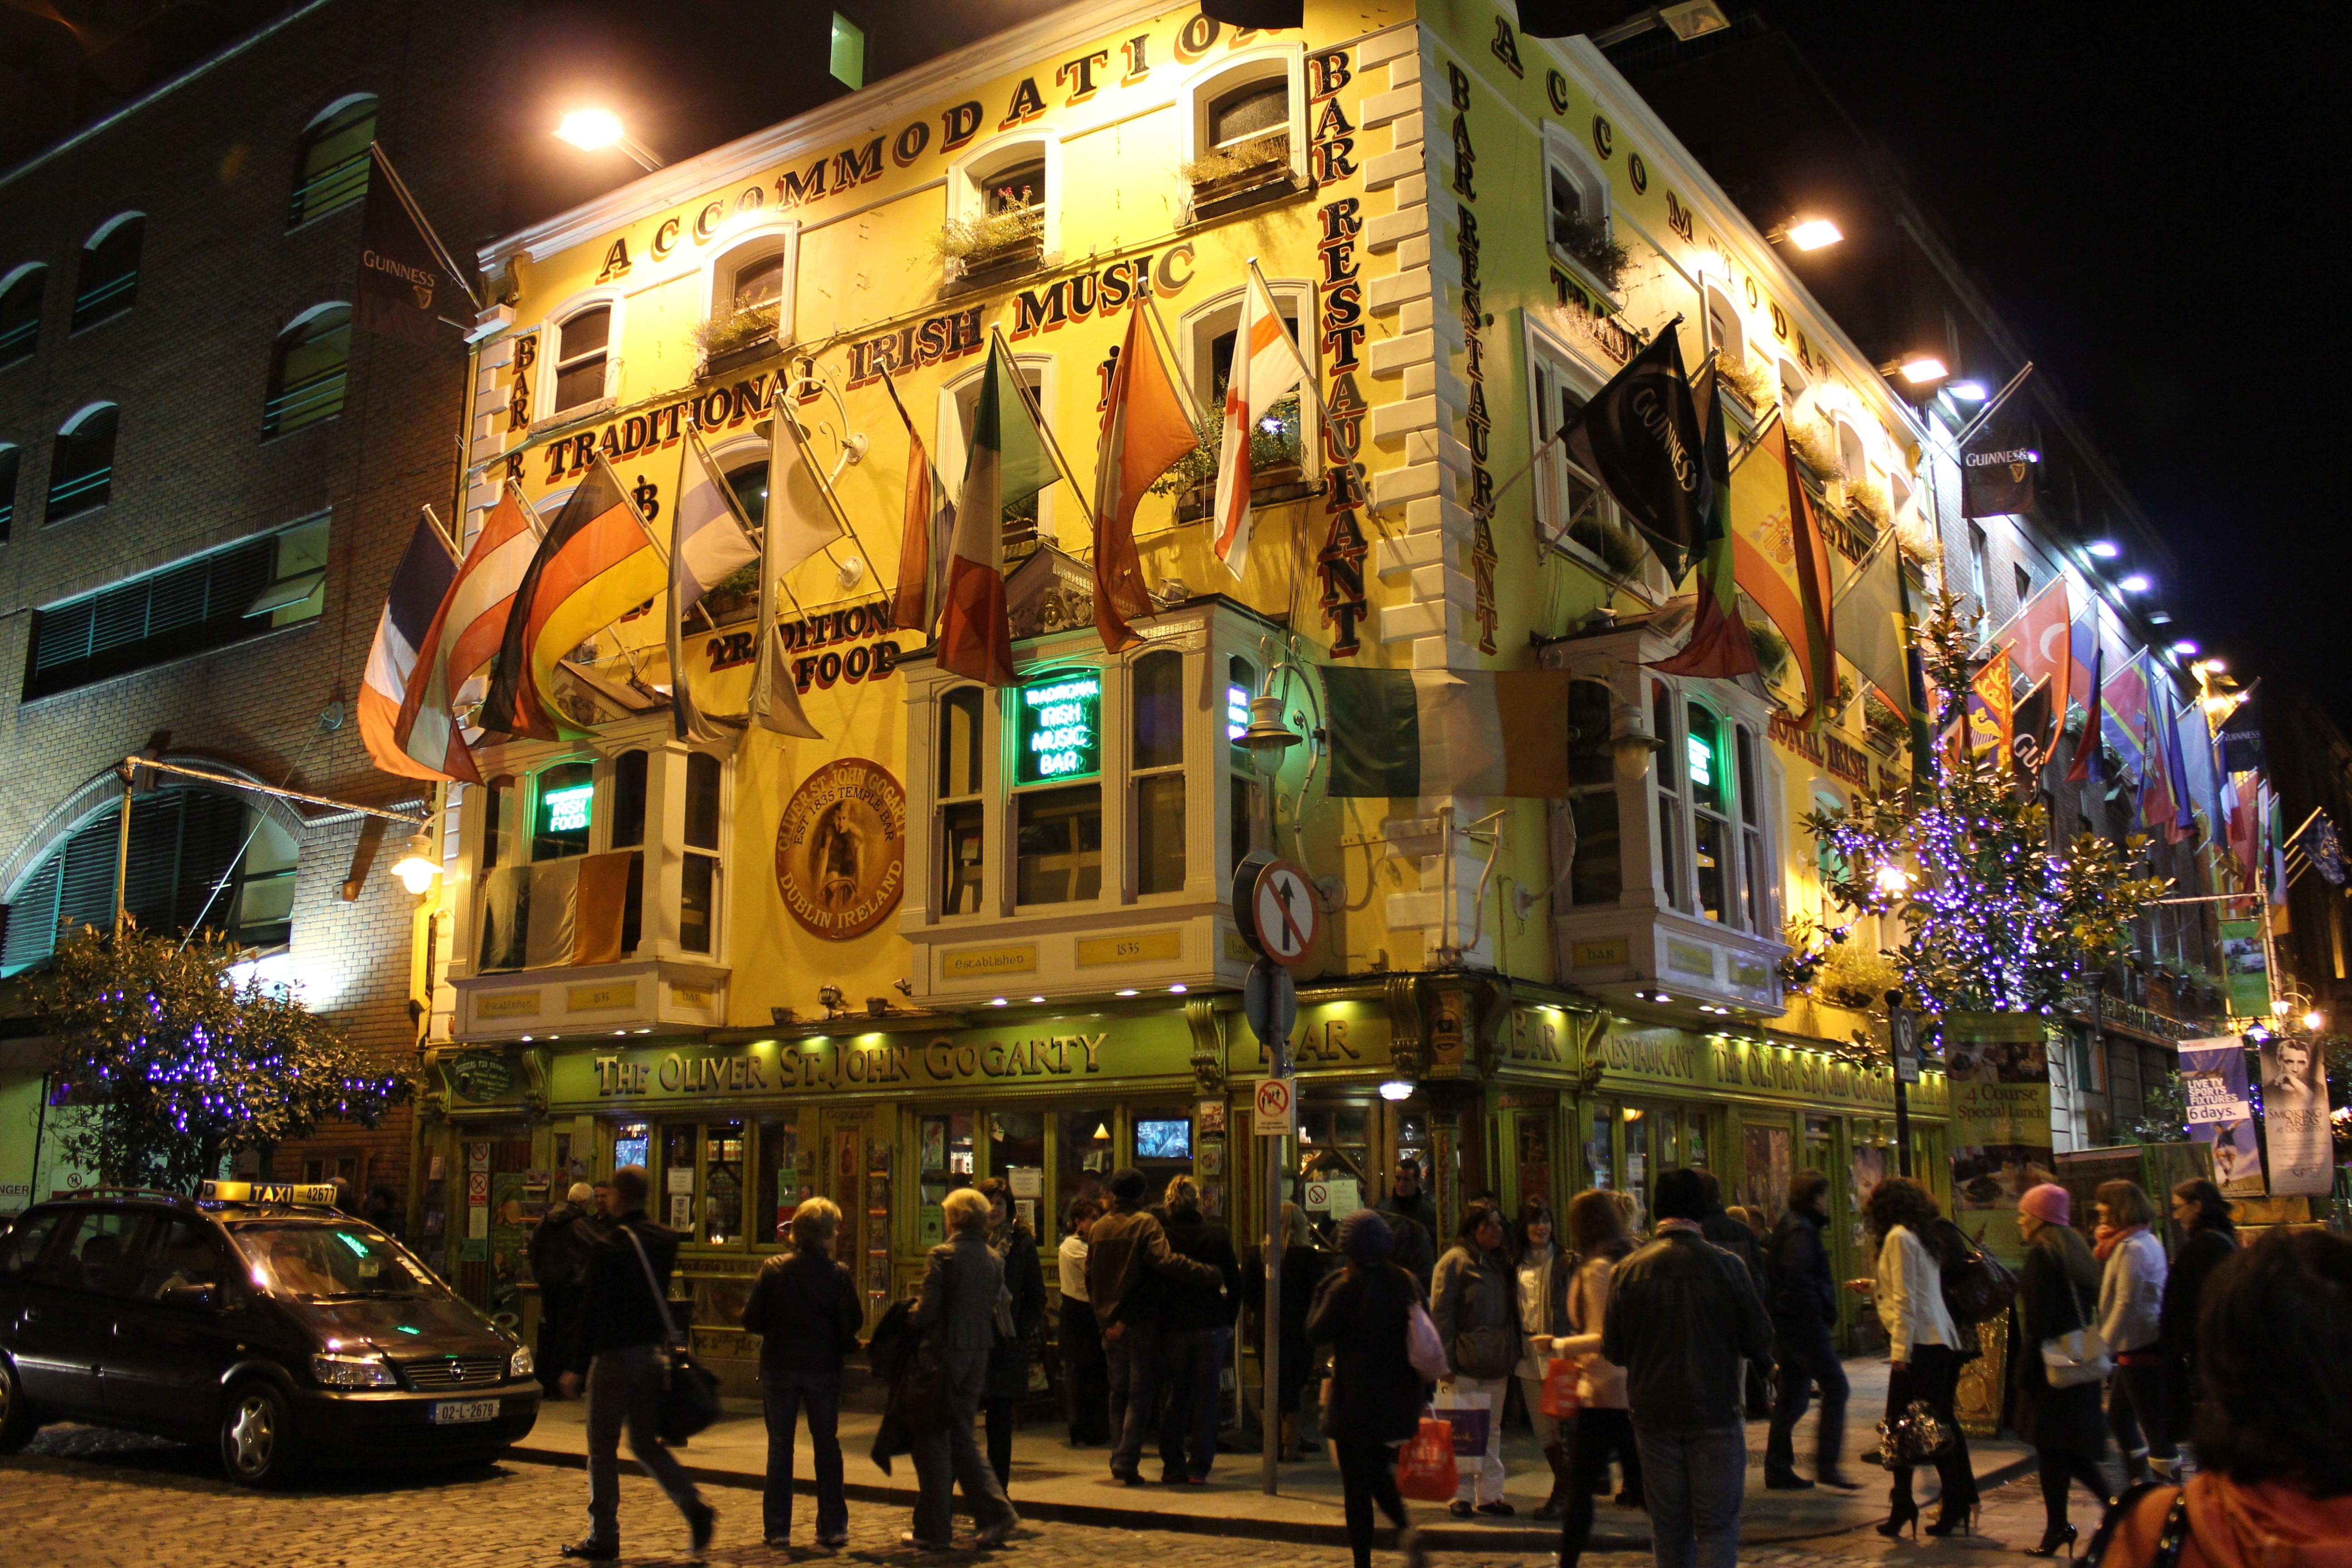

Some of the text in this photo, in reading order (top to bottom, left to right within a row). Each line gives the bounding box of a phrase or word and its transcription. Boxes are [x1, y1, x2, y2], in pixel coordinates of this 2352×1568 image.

[594, 11, 1282, 285] ACCOMMODATIO
[363, 250, 436, 287] GUINNESS
[545, 358, 826, 485] TRADITIONAL
[847, 303, 985, 391] IRISH
[1010, 242, 1196, 343] MUSIC
[1310, 51, 1367, 659] BAR RESTAURANT
[1447, 60, 1499, 656] BAR RESTAURANT
[508, 335, 537, 432] BAR
[1633, 387, 1698, 492] GUINNESS
[1966, 447, 2027, 466] GUINNESS
[790, 641, 901, 695] FOOD
[1041, 702, 1081, 727] IRISH
[1032, 725, 1087, 751] MUSIC
[1040, 751, 1078, 775] BAR
[778, 768, 906, 851] OLIVER ST JOHN GOGARTY
[794, 786, 894, 845] EST 1835 TEMPLE BAR
[780, 860, 902, 929] DUBLIN IRELAND
[1117, 941, 1140, 956] 1835
[1511, 1009, 1562, 1063] BAR
[595, 1055, 651, 1096] THE
[659, 1052, 768, 1092] OLIVER
[827, 1044, 911, 1089] JOHN
[924, 1032, 1110, 1081] GOGARTY
[1600, 1034, 1695, 1079] RESTAURANT
[1712, 1044, 1743, 1085] THE
[1965, 1087, 1977, 1105] 4
[1981, 1083, 2038, 1102] Course
[2187, 1078, 2224, 1089] LIVE TV
[2189, 1086, 2227, 1098] SPORTS
[2190, 1093, 2239, 1106] FIXTURES
[1958, 1103, 2045, 1122] Special Lunch
[2190, 1106, 2236, 1120] 6 days.
[254, 1185, 292, 1202] TAXI
[306, 1187, 335, 1202] 42677
[442, 1403, 493, 1420] 02-L-2679
